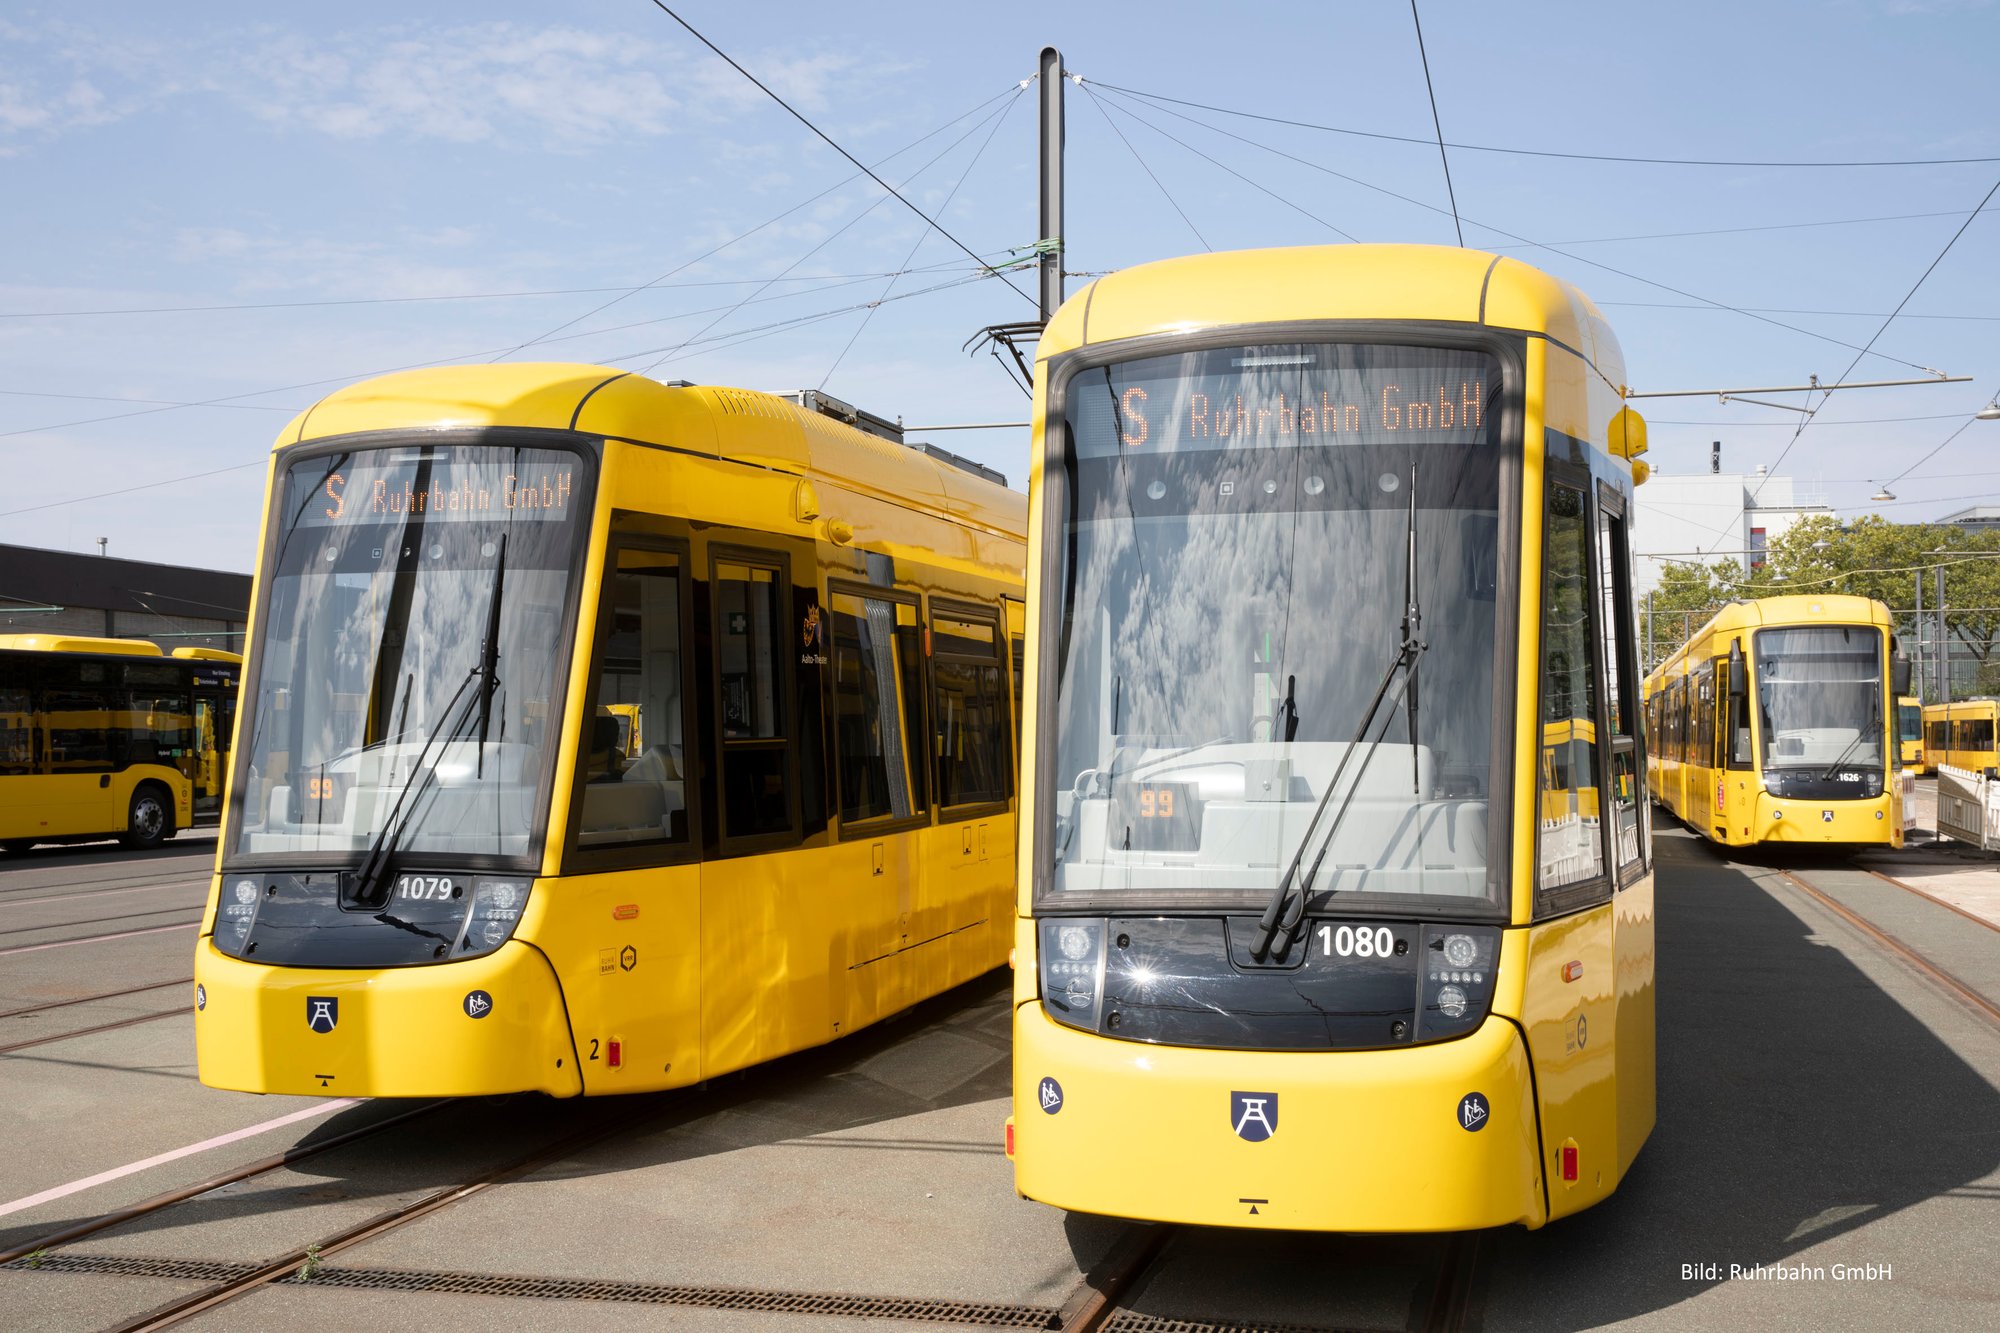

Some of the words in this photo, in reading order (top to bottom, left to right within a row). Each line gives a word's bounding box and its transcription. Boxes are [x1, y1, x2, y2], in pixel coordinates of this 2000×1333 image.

[1122, 387, 1148, 446] S
[1191, 391, 1360, 438] Ruhrbahn
[1383, 381, 1481, 431] GmbH
[326, 473, 345, 519] S
[373, 479, 490, 513] Ruhrbahn
[504, 472, 571, 510] GmbH
[310, 778, 333, 799] 99
[1839, 773, 1860, 782] 1626
[1141, 790, 1173, 817] 99
[400, 877, 452, 900] 1079
[1317, 926, 1394, 958] 1080
[589, 1038, 599, 1060] 2
[1554, 1147, 1559, 1176] 1
